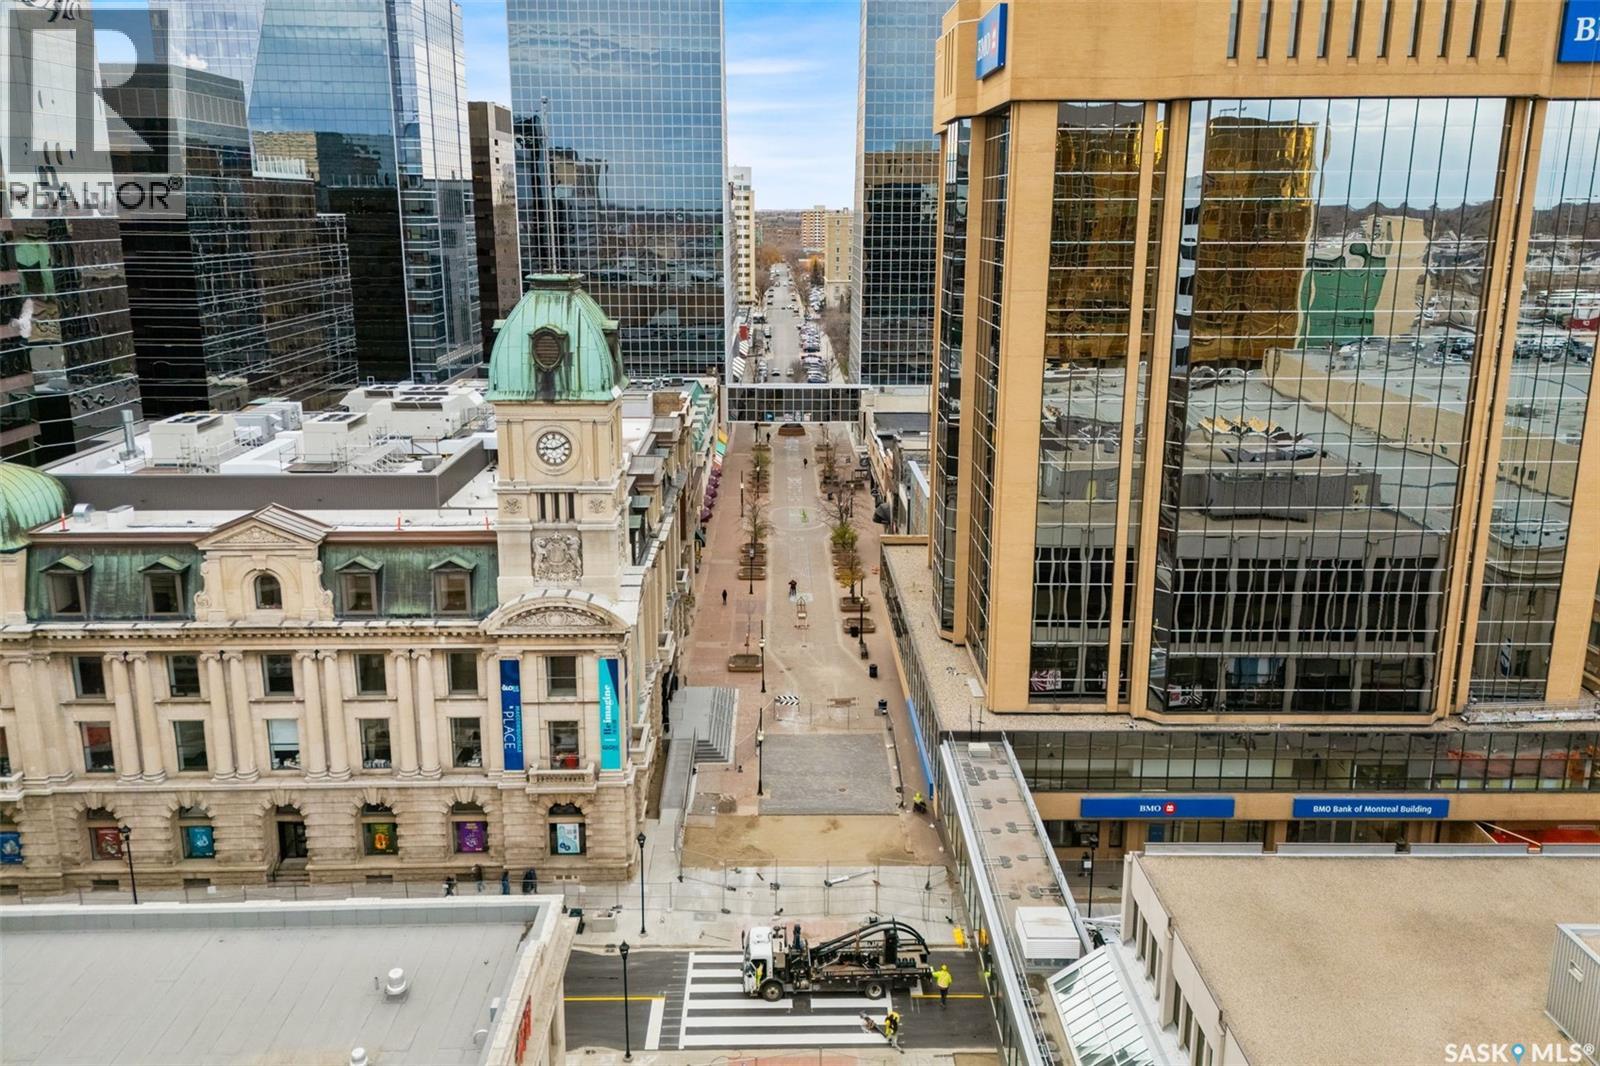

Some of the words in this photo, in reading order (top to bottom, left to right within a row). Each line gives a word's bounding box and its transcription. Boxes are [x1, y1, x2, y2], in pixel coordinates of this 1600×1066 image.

[1139, 804, 1162, 813] BMO
[1312, 805, 1332, 813] BMO
[1333, 805, 1353, 813] Bank
[1354, 805, 1363, 813] of
[1364, 805, 1399, 813] Montreal
[1400, 805, 1432, 815] Building
